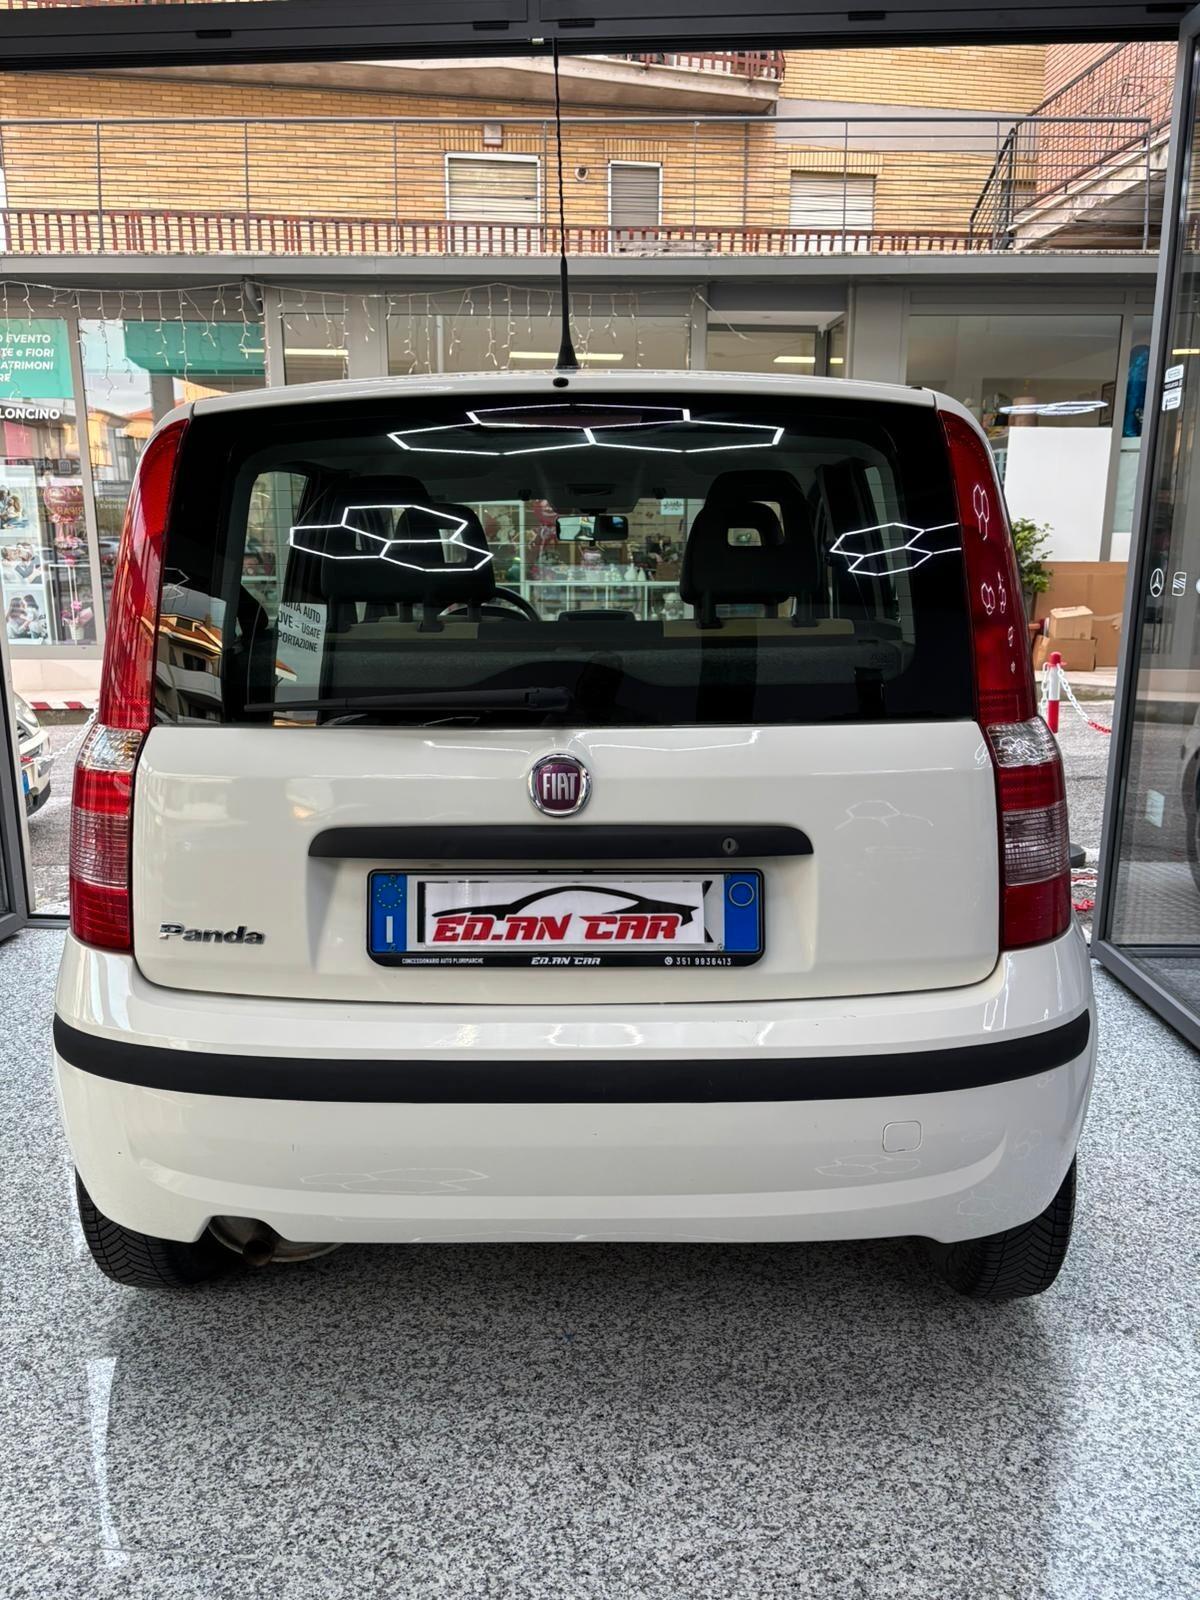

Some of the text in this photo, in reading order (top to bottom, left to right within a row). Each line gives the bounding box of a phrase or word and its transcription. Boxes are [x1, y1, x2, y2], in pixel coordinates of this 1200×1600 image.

[6, 334, 51, 344] EVENTO
[25, 348, 54, 357] FIORI
[303, 605, 321, 623] AUTO
[301, 622, 321, 639] USATE
[543, 773, 577, 800] FIAT
[159, 921, 265, 944] Panda
[432, 913, 680, 942] ED.AN CAR
[440, 957, 452, 965] AUTO
[573, 957, 601, 966] CAR
[676, 957, 691, 966] 351
